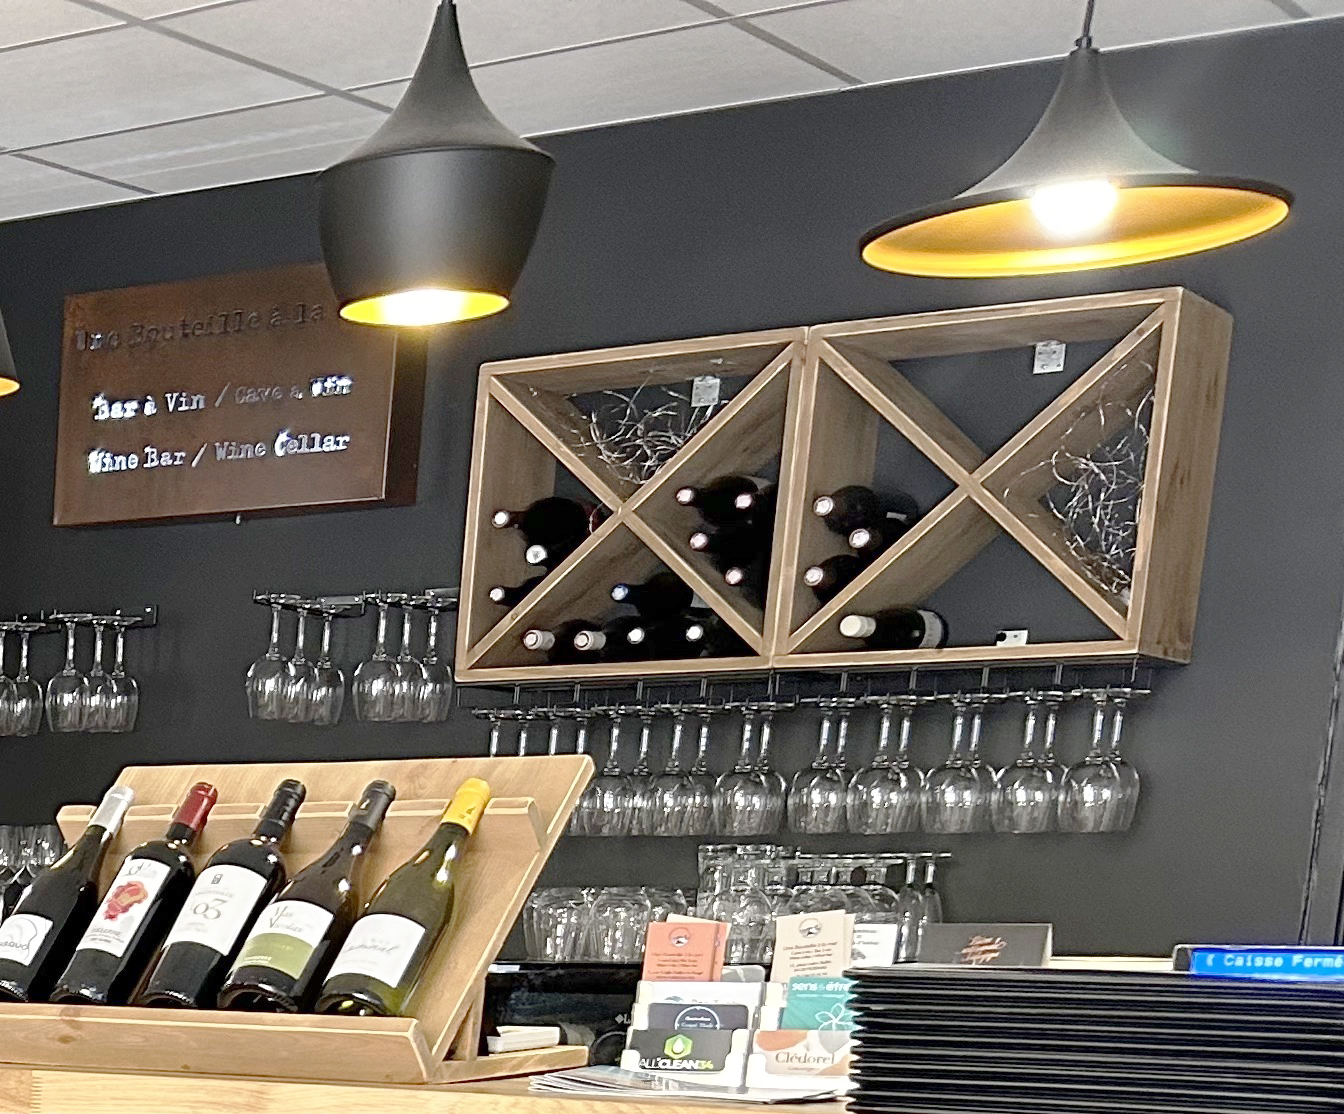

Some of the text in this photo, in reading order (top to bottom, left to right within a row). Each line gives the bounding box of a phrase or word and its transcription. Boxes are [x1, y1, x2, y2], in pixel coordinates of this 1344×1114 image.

[128, 307, 261, 349] Bouteille
[295, 301, 325, 326] la
[93, 392, 139, 421] Bar
[144, 395, 158, 417] à
[164, 390, 206, 413] Vin
[234, 383, 283, 406] Cave
[309, 374, 354, 398] Vin
[87, 447, 139, 475] Wine
[142, 445, 187, 469] Bar
[215, 438, 267, 463] Wine
[273, 428, 351, 457] Cellar
[1223, 953, 1284, 968] Caisse
[1291, 953, 1344, 969] Fermé
[792, 982, 818, 991] sens
[775, 1051, 835, 1065] Clédorel
